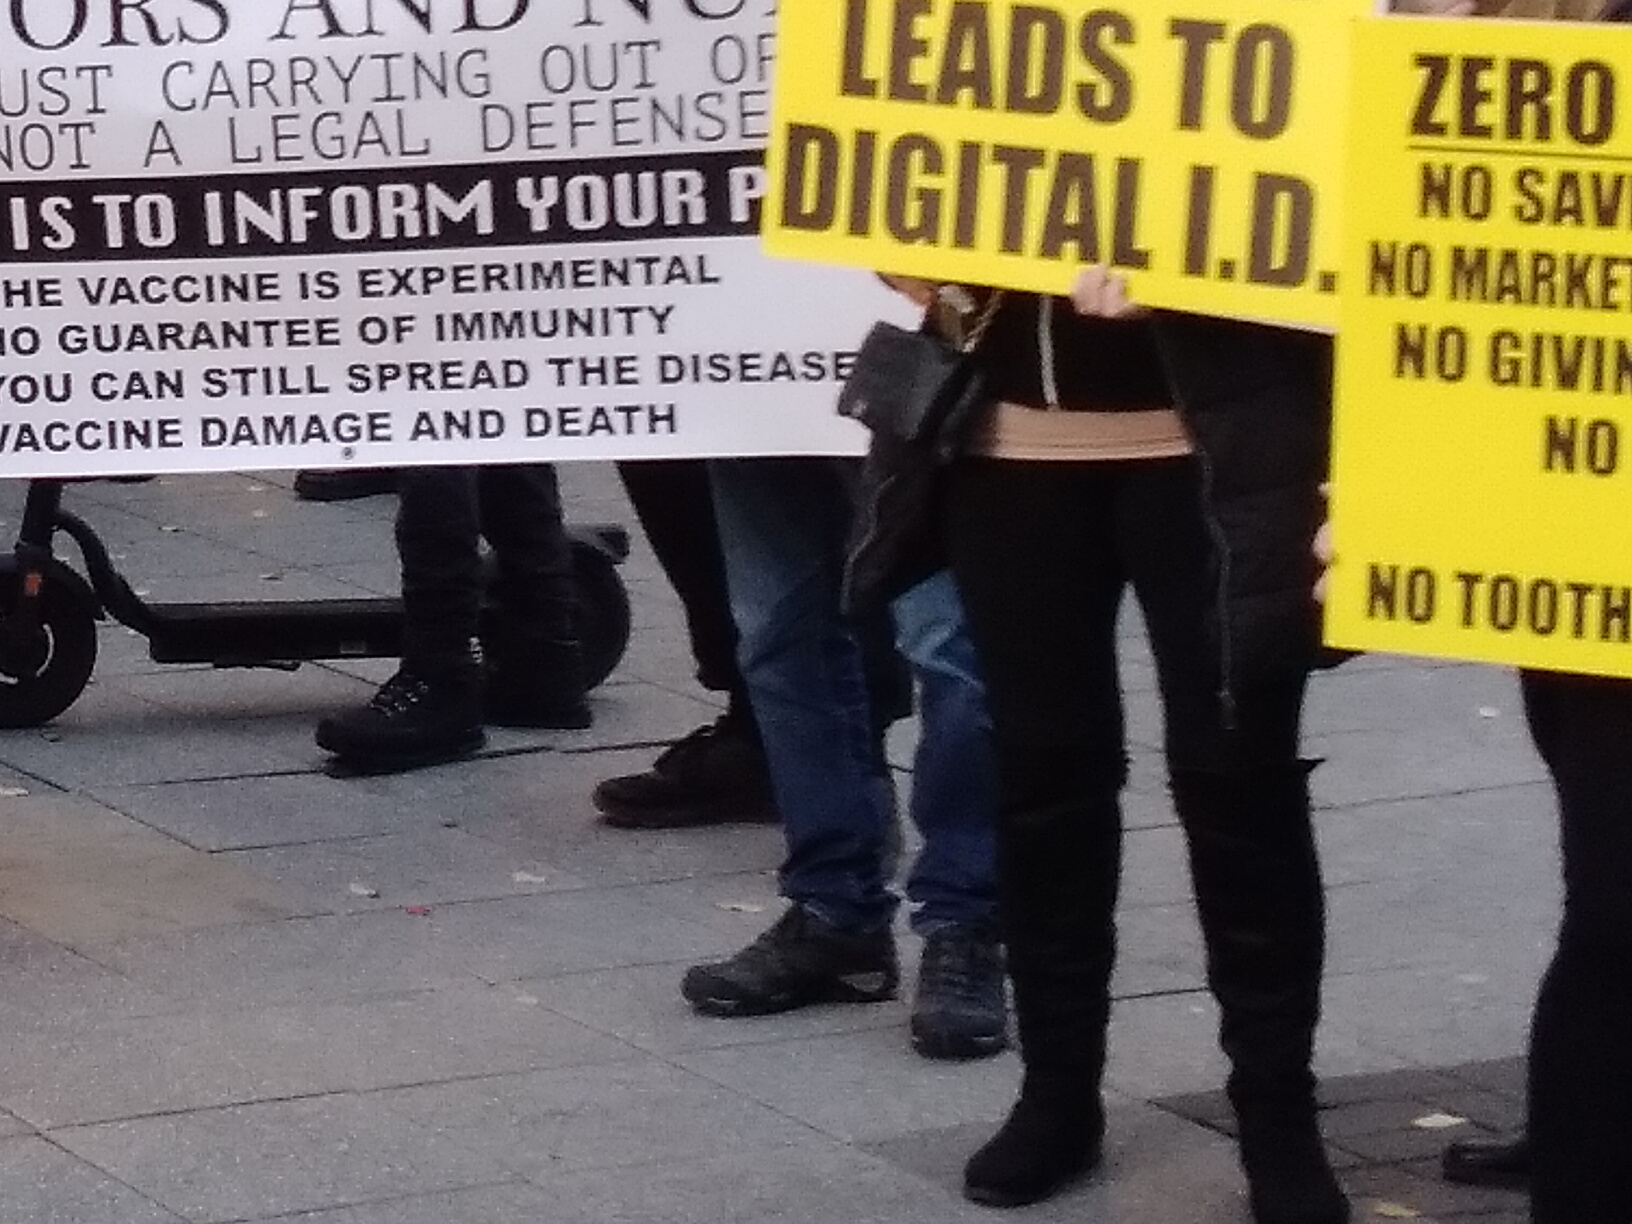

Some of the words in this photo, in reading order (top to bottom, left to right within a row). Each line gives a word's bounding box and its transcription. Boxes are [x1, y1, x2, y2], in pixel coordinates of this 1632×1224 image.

[162, 48, 491, 112] CARRYING
[540, 40, 661, 94] OUT
[1169, 16, 1297, 141] TO
[1409, 51, 1617, 147] ZERO
[143, 120, 184, 168] A
[229, 108, 431, 164] LEGAL
[480, 91, 768, 153] DEFENSE
[10, 195, 76, 251] IS
[92, 192, 177, 250] TO
[204, 180, 494, 247] INFORM
[516, 169, 707, 234] YOUR
[779, 121, 1153, 270] DIGITAL
[1182, 163, 1341, 294] I.D.
[1417, 161, 1495, 221] NO
[1512, 168, 1632, 230] SAV
[77, 273, 282, 307] VACCINE
[299, 270, 341, 301] IS
[357, 254, 721, 300] EXPERIMENTAL
[1366, 239, 1432, 299] NO
[1448, 245, 1632, 314] MARKE
[58, 317, 341, 356] GUARANTEE
[358, 314, 418, 345] OF
[435, 304, 675, 343] IMMUNITY
[1391, 322, 1469, 384] NO
[90, 369, 186, 402] CAN
[202, 364, 331, 399] STILL
[346, 357, 531, 395] SPREAD
[548, 355, 640, 387] THE
[659, 349, 860, 385] DISEASE
[200, 410, 393, 449] DAMAGE
[410, 408, 506, 442] AND
[525, 402, 679, 438] DEATH
[1541, 413, 1619, 477] NO
[1364, 562, 1437, 625] NO
[1454, 571, 1632, 644] TOOTH
